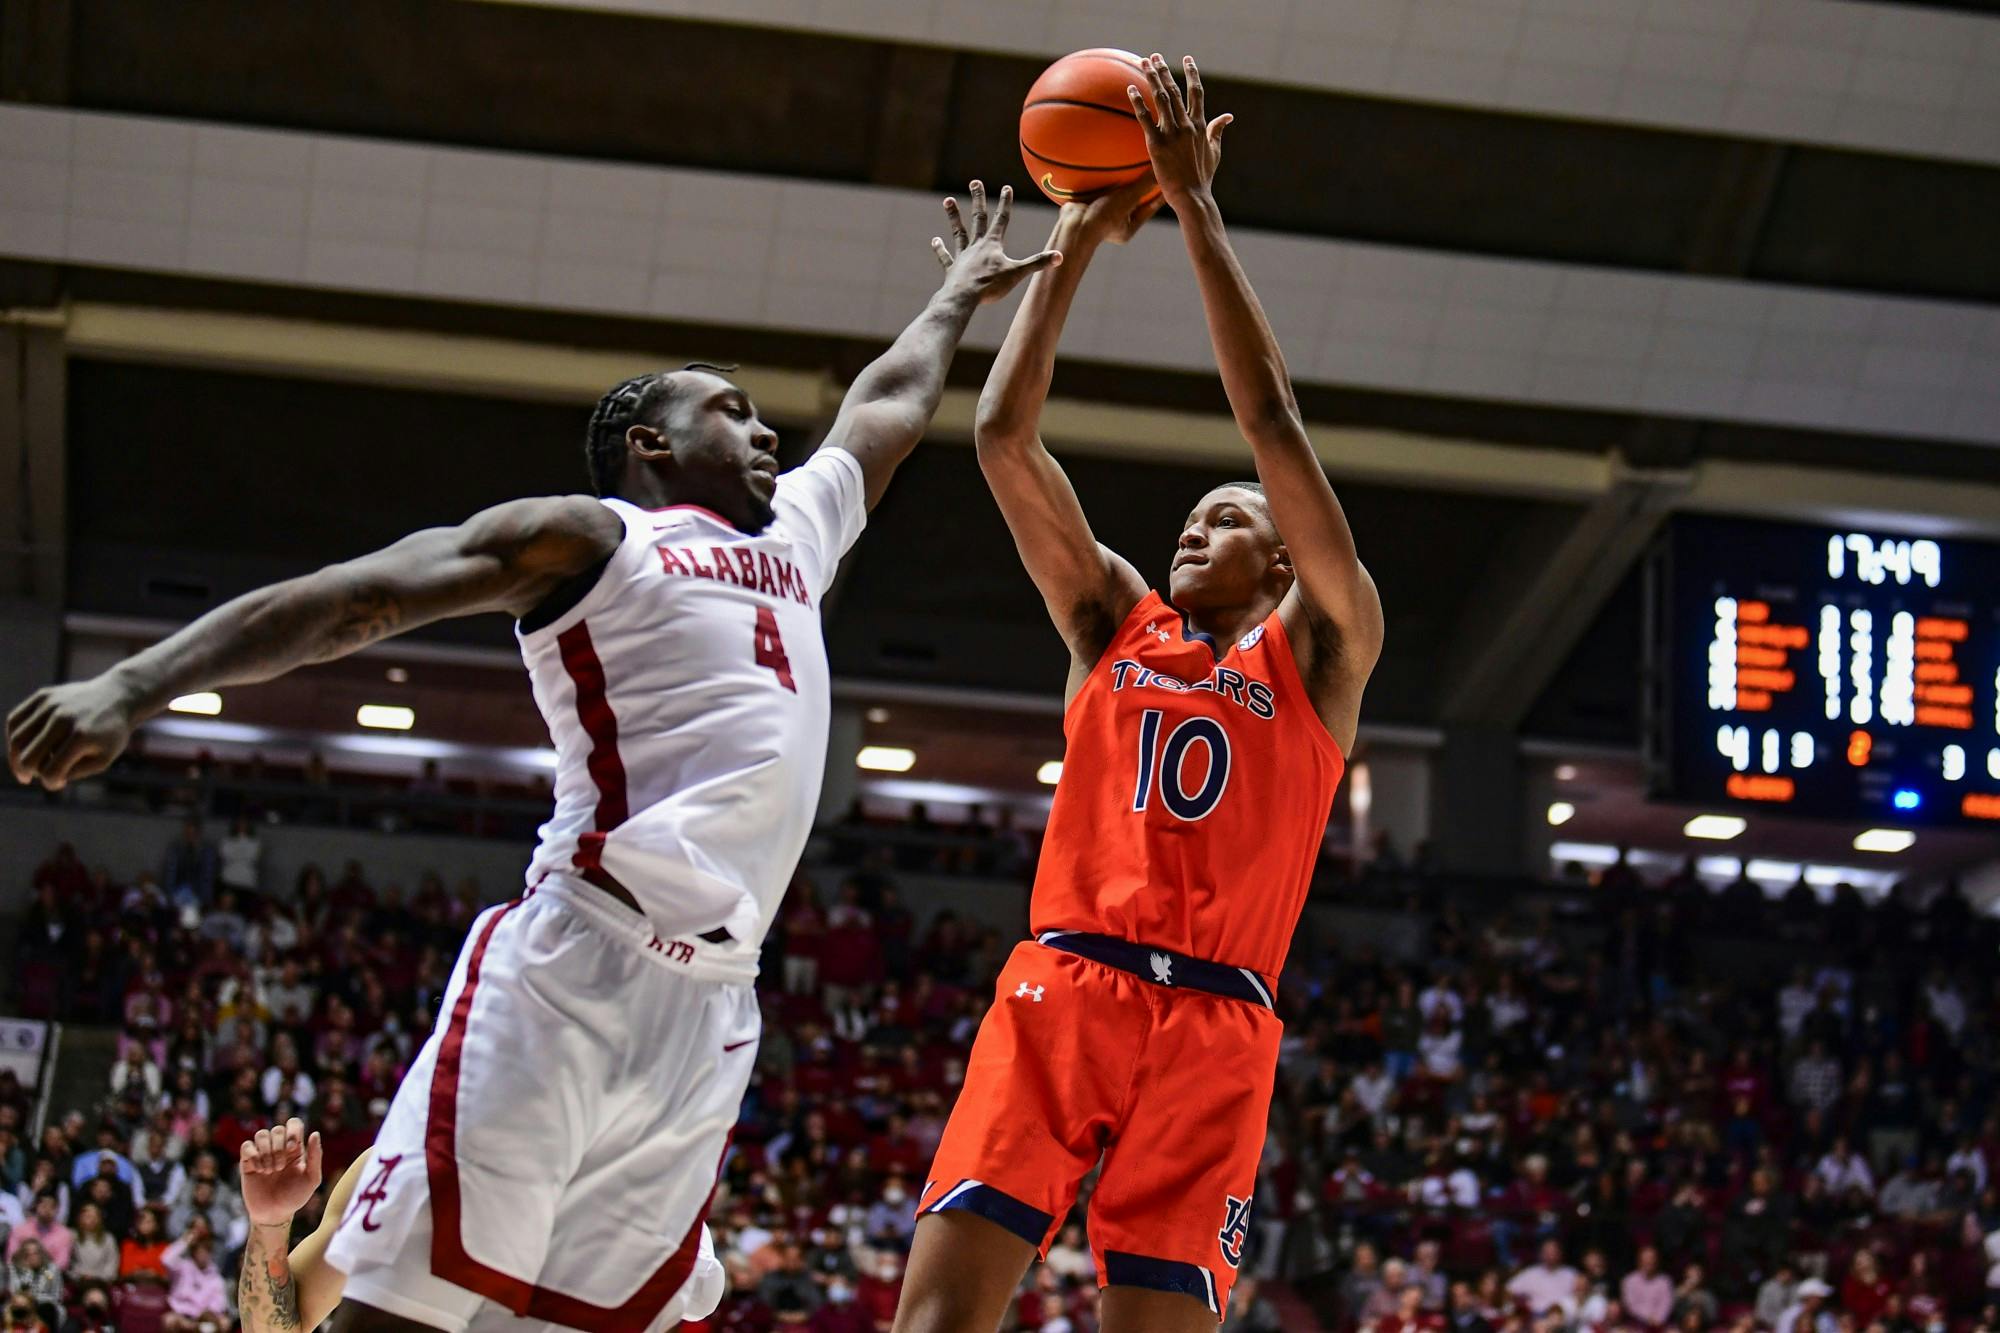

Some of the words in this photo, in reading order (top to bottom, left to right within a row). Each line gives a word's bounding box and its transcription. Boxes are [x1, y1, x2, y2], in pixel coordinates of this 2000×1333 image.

[656, 546, 813, 611] ALABAMA
[755, 606, 797, 694] 4
[1133, 709, 1231, 822] 10
